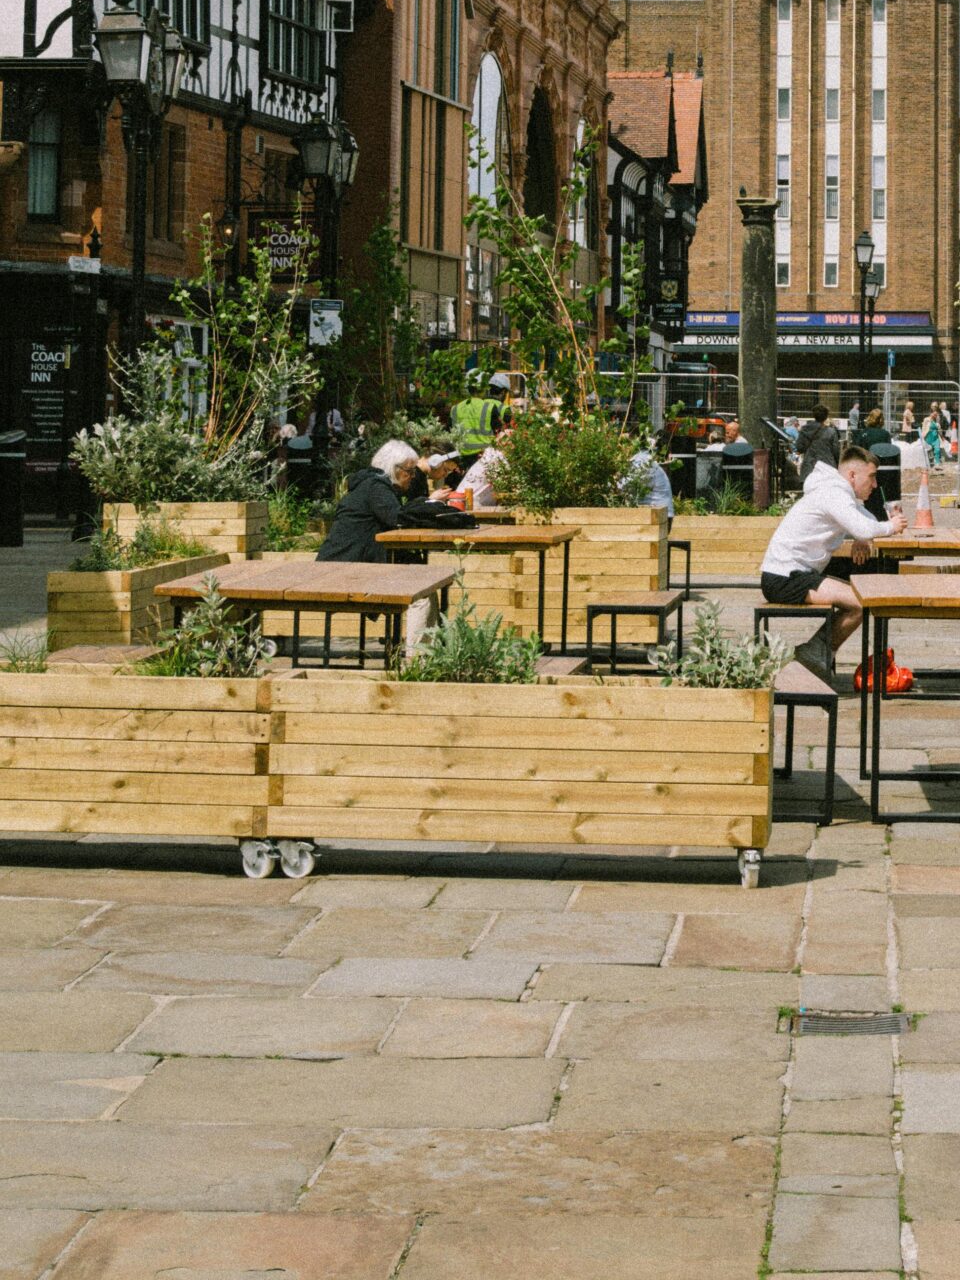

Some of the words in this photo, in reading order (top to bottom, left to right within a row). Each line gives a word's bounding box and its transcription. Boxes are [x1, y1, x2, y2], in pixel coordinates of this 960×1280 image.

[270, 247, 300, 256] HOUSE
[270, 257, 293, 268] INN
[825, 314, 848, 324] NOW
[697, 335, 740, 344] DOWNT
[793, 336, 800, 344] A
[806, 336, 829, 344] NEW
[834, 336, 853, 344] ERA
[31, 343, 46, 351] THE
[31, 363, 58, 371] HOUSE
[31, 372, 51, 382] INN
